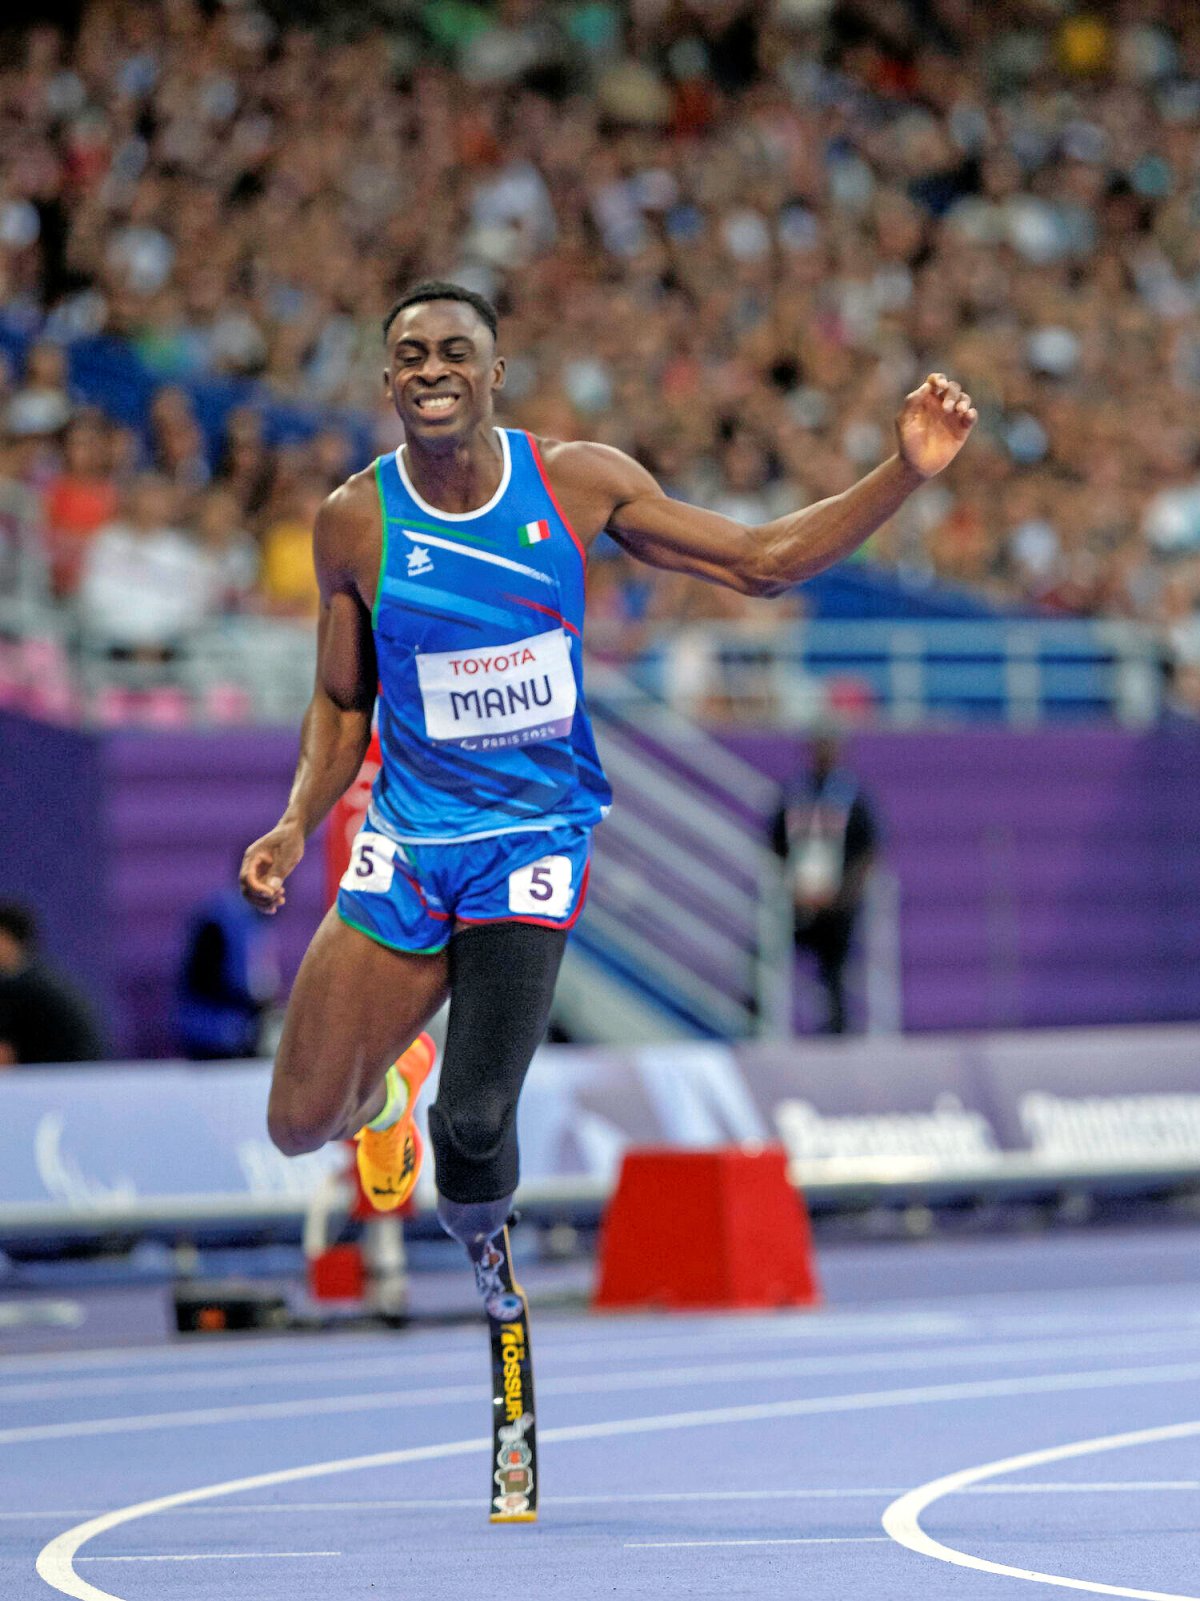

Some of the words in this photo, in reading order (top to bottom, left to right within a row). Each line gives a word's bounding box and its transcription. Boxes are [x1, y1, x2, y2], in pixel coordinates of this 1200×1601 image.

[449, 648, 536, 676] TOYOTA
[450, 675, 552, 720] MANU
[482, 735, 519, 749] PARIS
[523, 727, 556, 742] 2024
[355, 846, 374, 877] 5
[529, 867, 553, 902] 5
